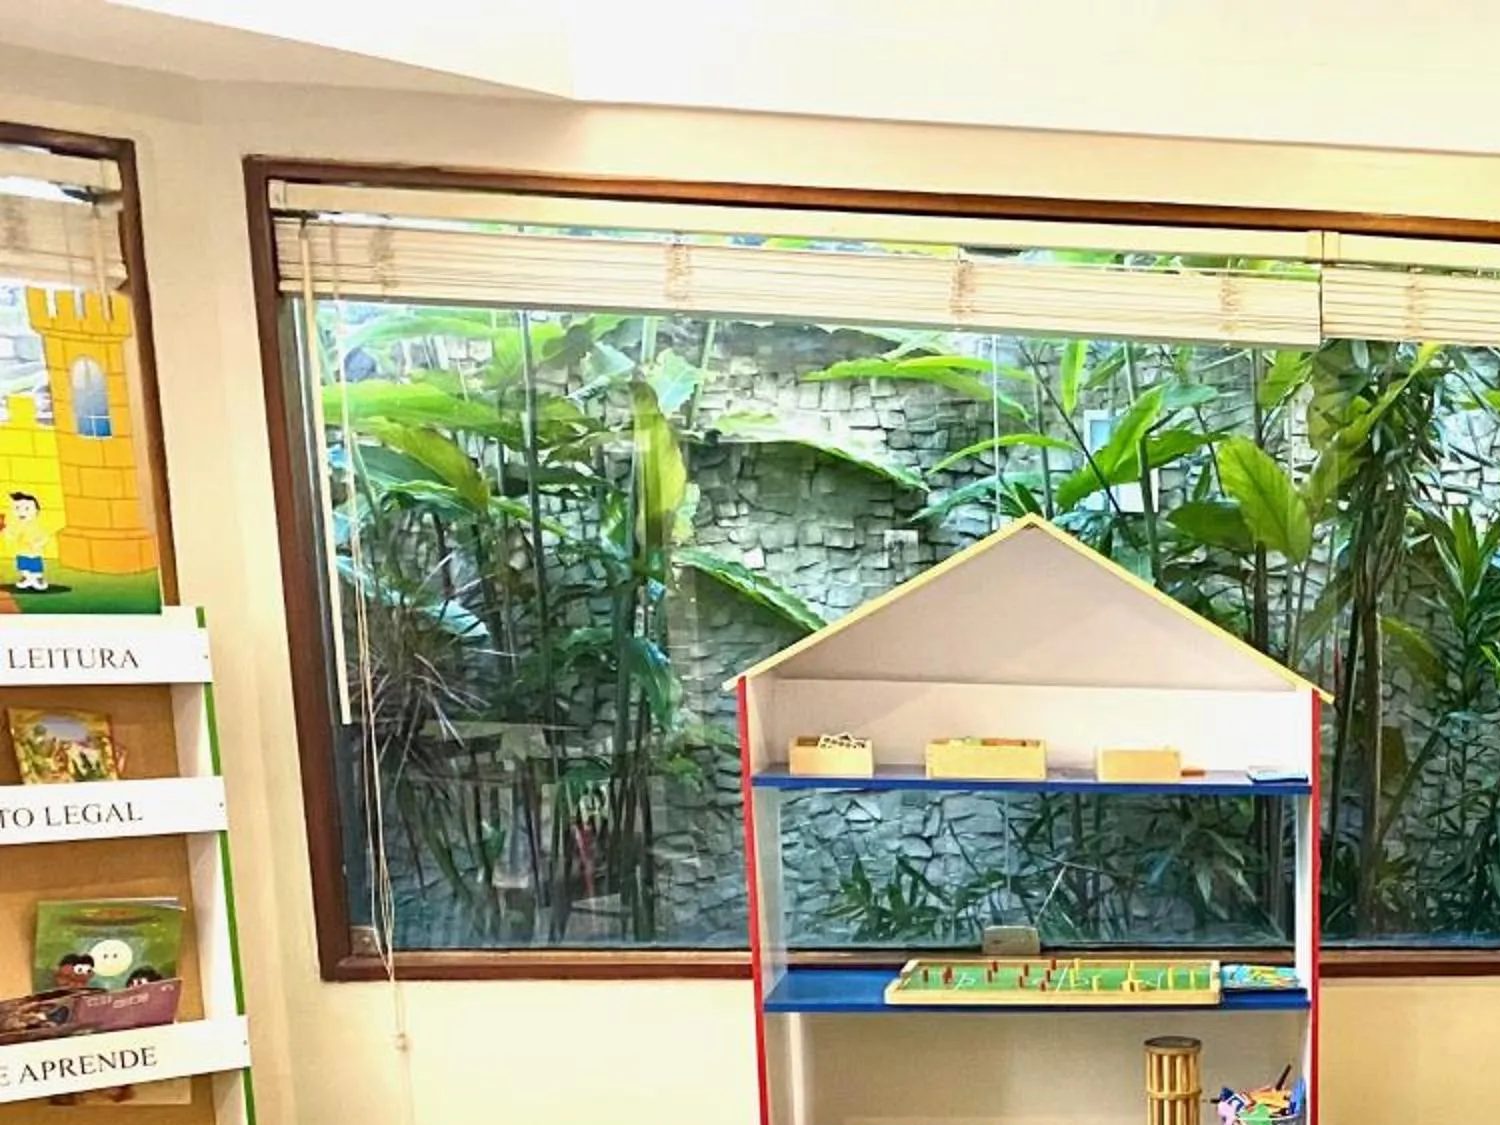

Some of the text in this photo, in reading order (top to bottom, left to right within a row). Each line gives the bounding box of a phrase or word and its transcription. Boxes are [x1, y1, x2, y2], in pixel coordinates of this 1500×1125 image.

[7, 647, 140, 670] LEITURA
[45, 801, 144, 827] LEGAL
[18, 1046, 158, 1085] APRENDE
